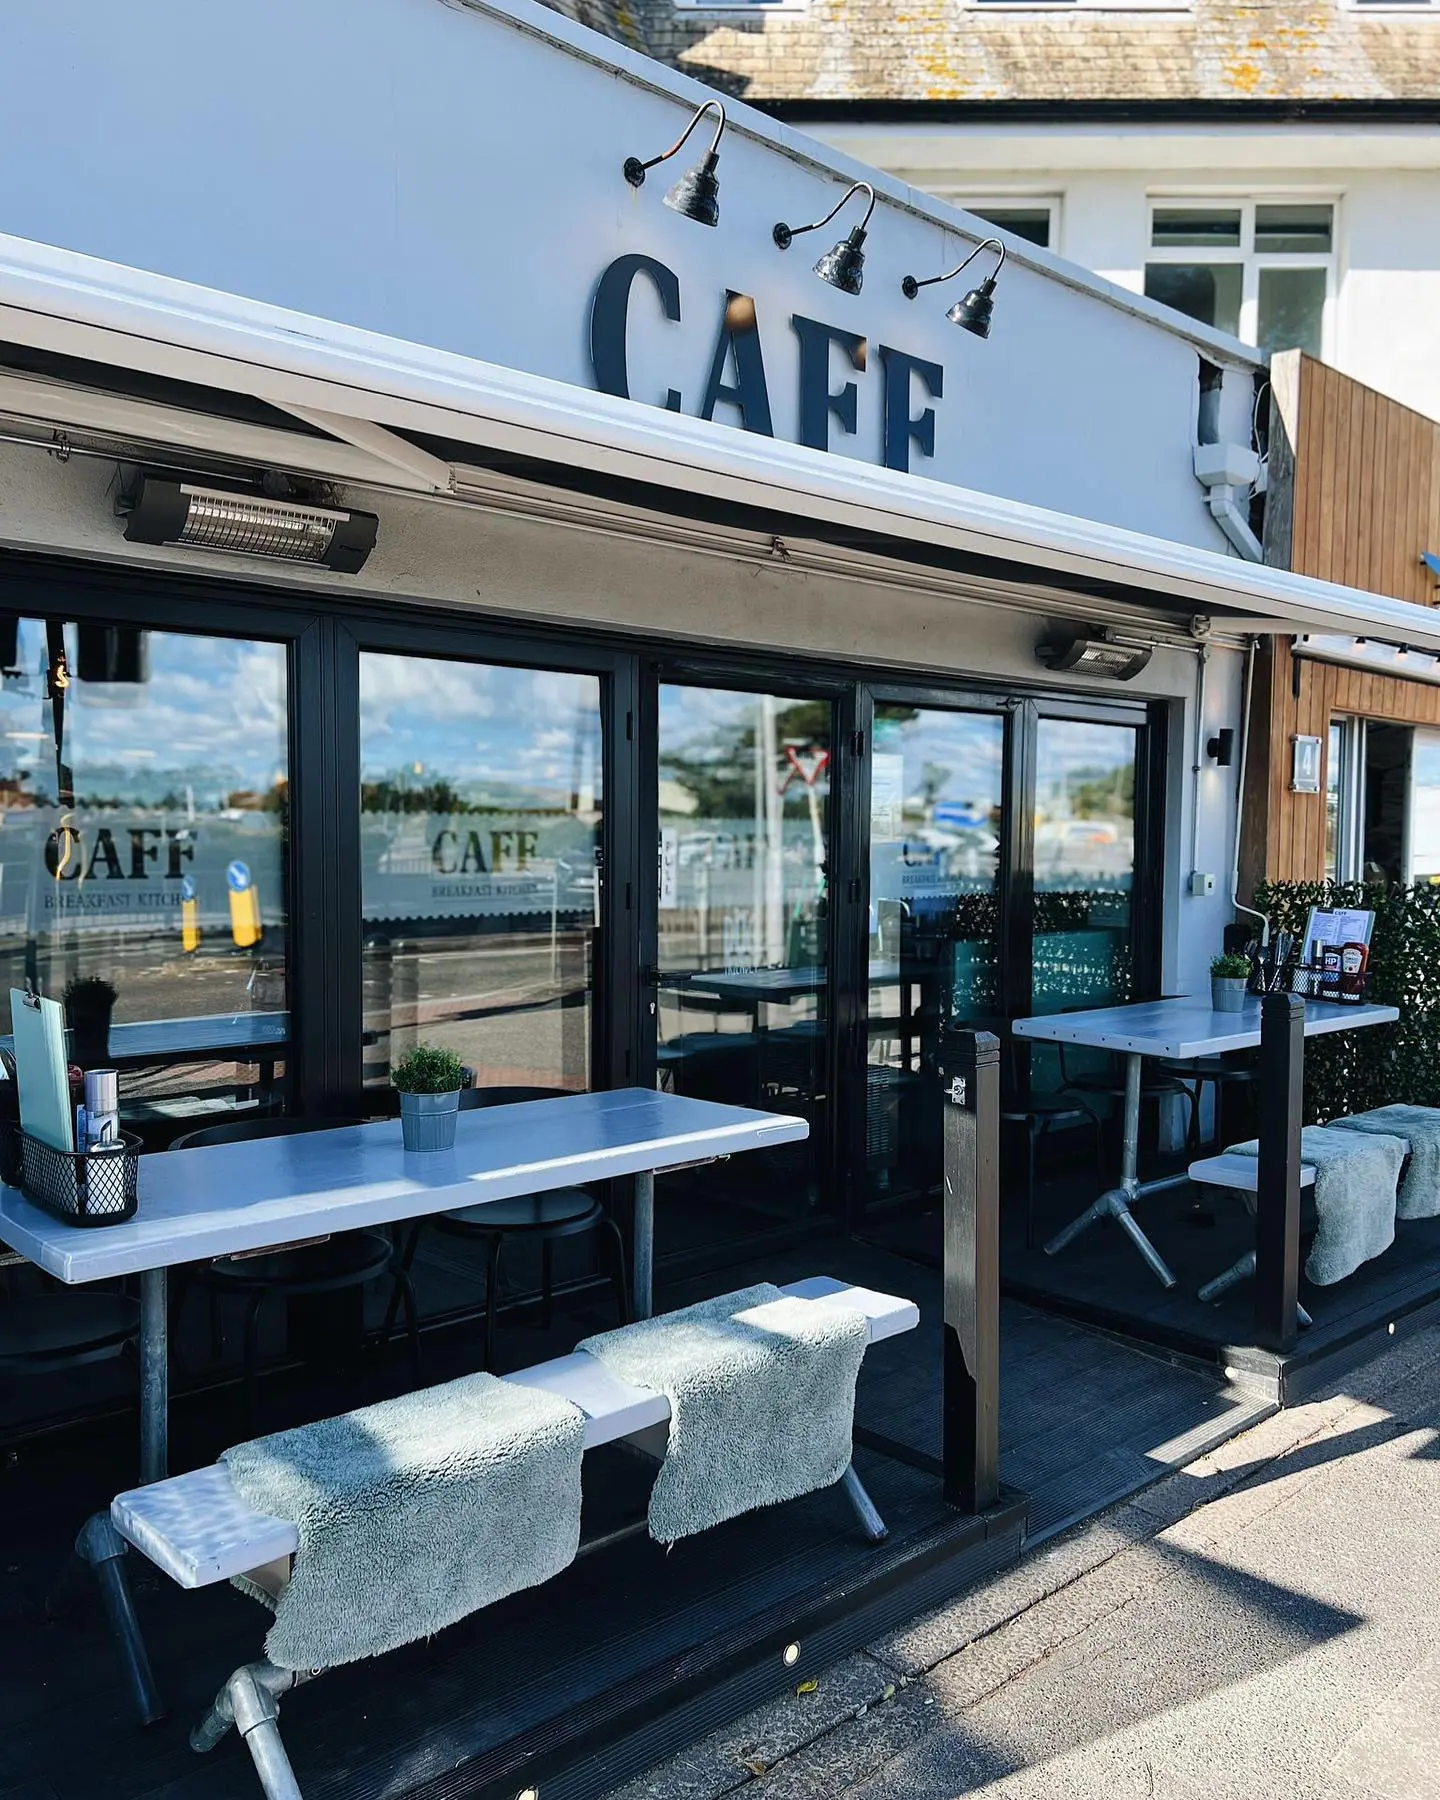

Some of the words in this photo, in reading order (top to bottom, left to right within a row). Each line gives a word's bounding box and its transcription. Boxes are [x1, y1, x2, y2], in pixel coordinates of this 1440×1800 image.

[591, 254, 943, 474] CAFF
[1303, 744, 1312, 776] 4
[44, 827, 198, 880] CAFF
[432, 830, 538, 874] CAFF
[44, 893, 131, 910] BREAKFAST
[138, 892, 182, 907] KITCH
[431, 884, 492, 898] BREAKFAST
[1324, 957, 1337, 966] HP
